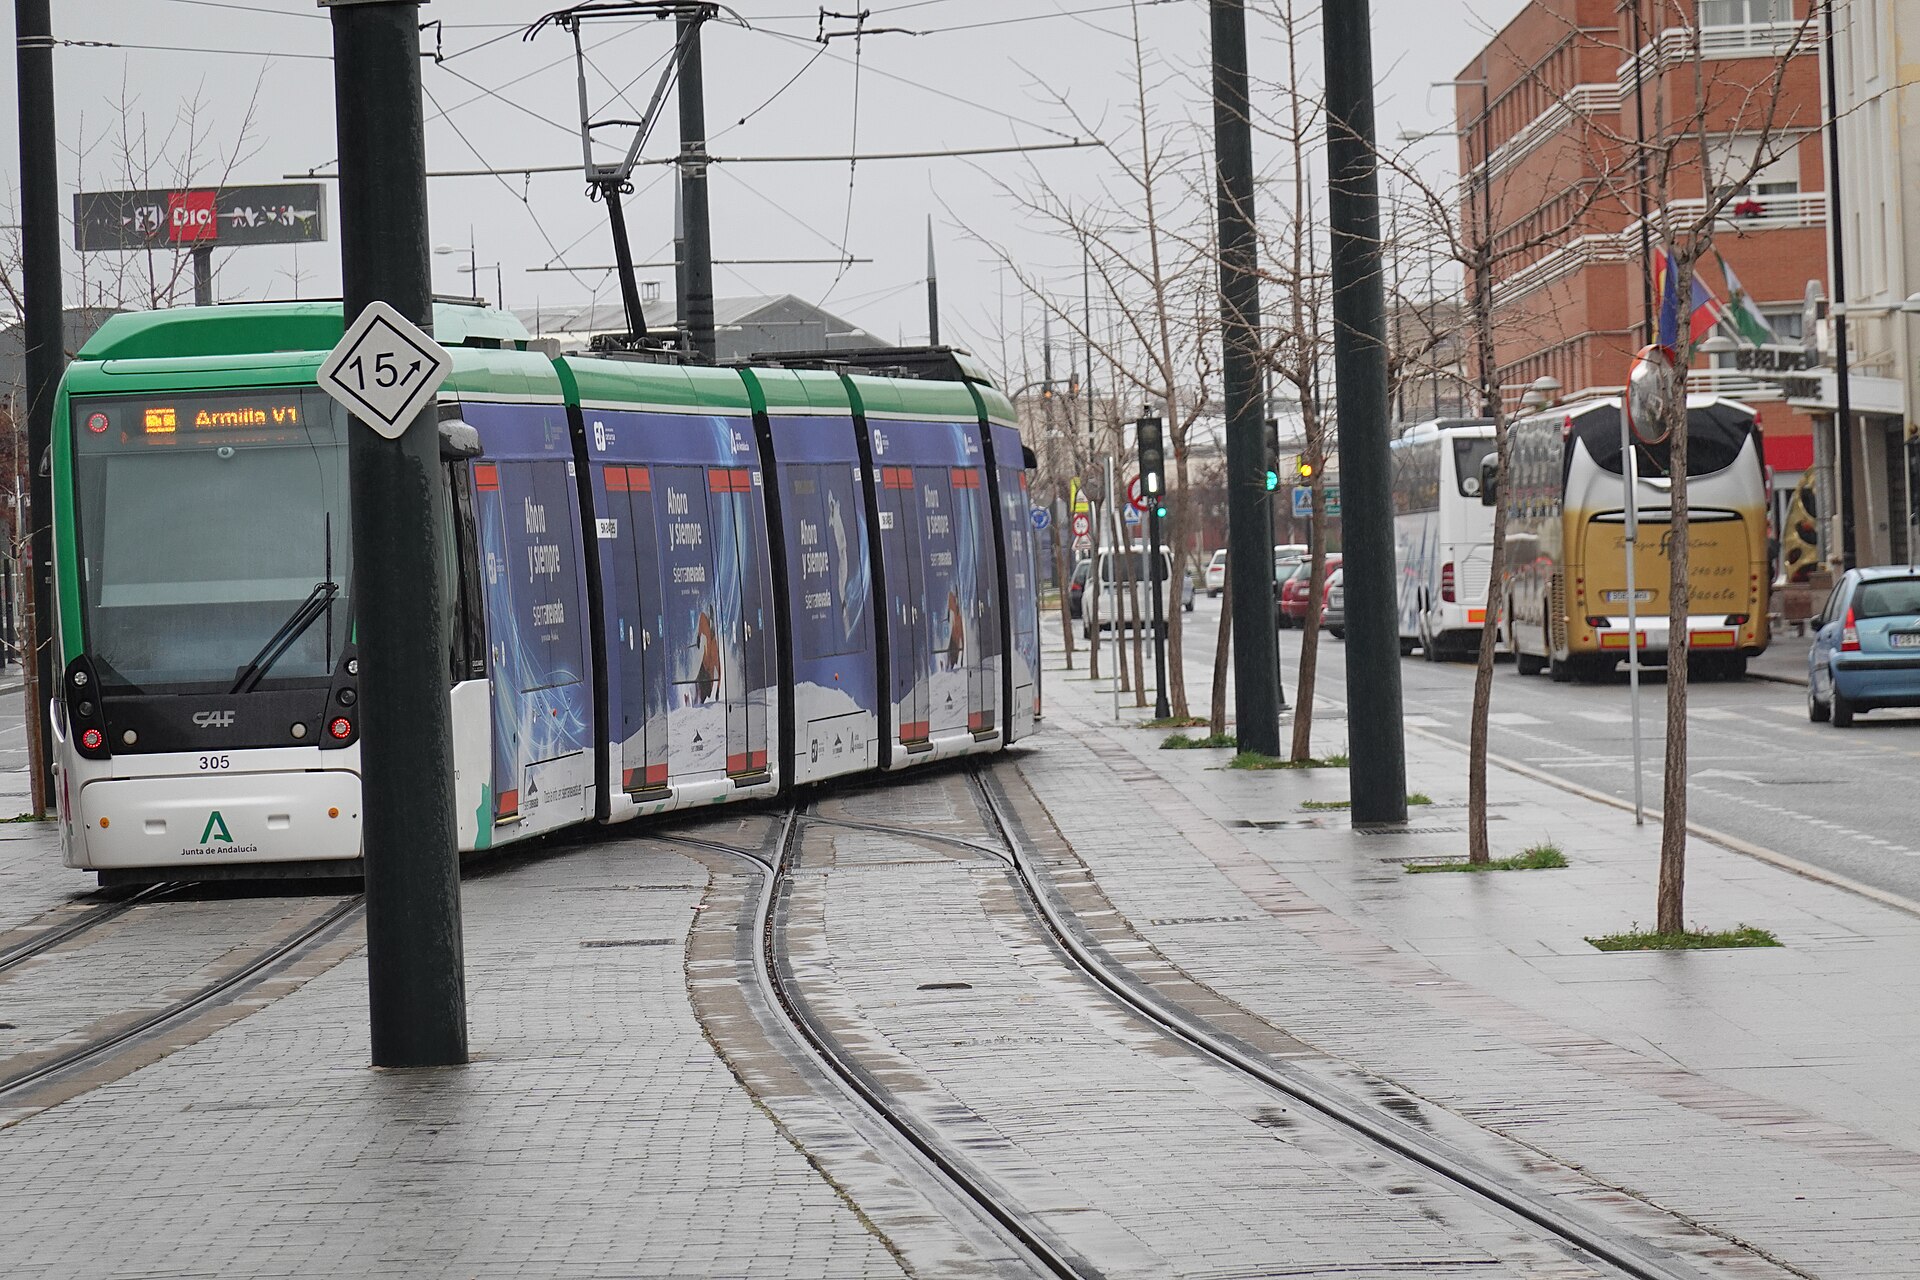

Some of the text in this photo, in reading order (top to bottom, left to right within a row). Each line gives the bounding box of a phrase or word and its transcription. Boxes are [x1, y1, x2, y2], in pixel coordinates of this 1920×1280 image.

[349, 352, 398, 390] 15
[196, 408, 266, 427] Armilla
[272, 406, 298, 424] V1
[525, 496, 546, 533] Ahora
[667, 487, 688, 515] Ahora
[669, 517, 702, 551] y siempre
[800, 519, 817, 545] Ahora
[527, 545, 534, 584] y
[534, 536, 561, 582] siempre
[673, 563, 706, 583] sierranevada
[802, 546, 829, 580] y siempre
[532, 599, 565, 626] sierranevada
[192, 710, 236, 728] CAF
[199, 755, 230, 770] 305
[181, 843, 258, 856] Junta de Andalucía
